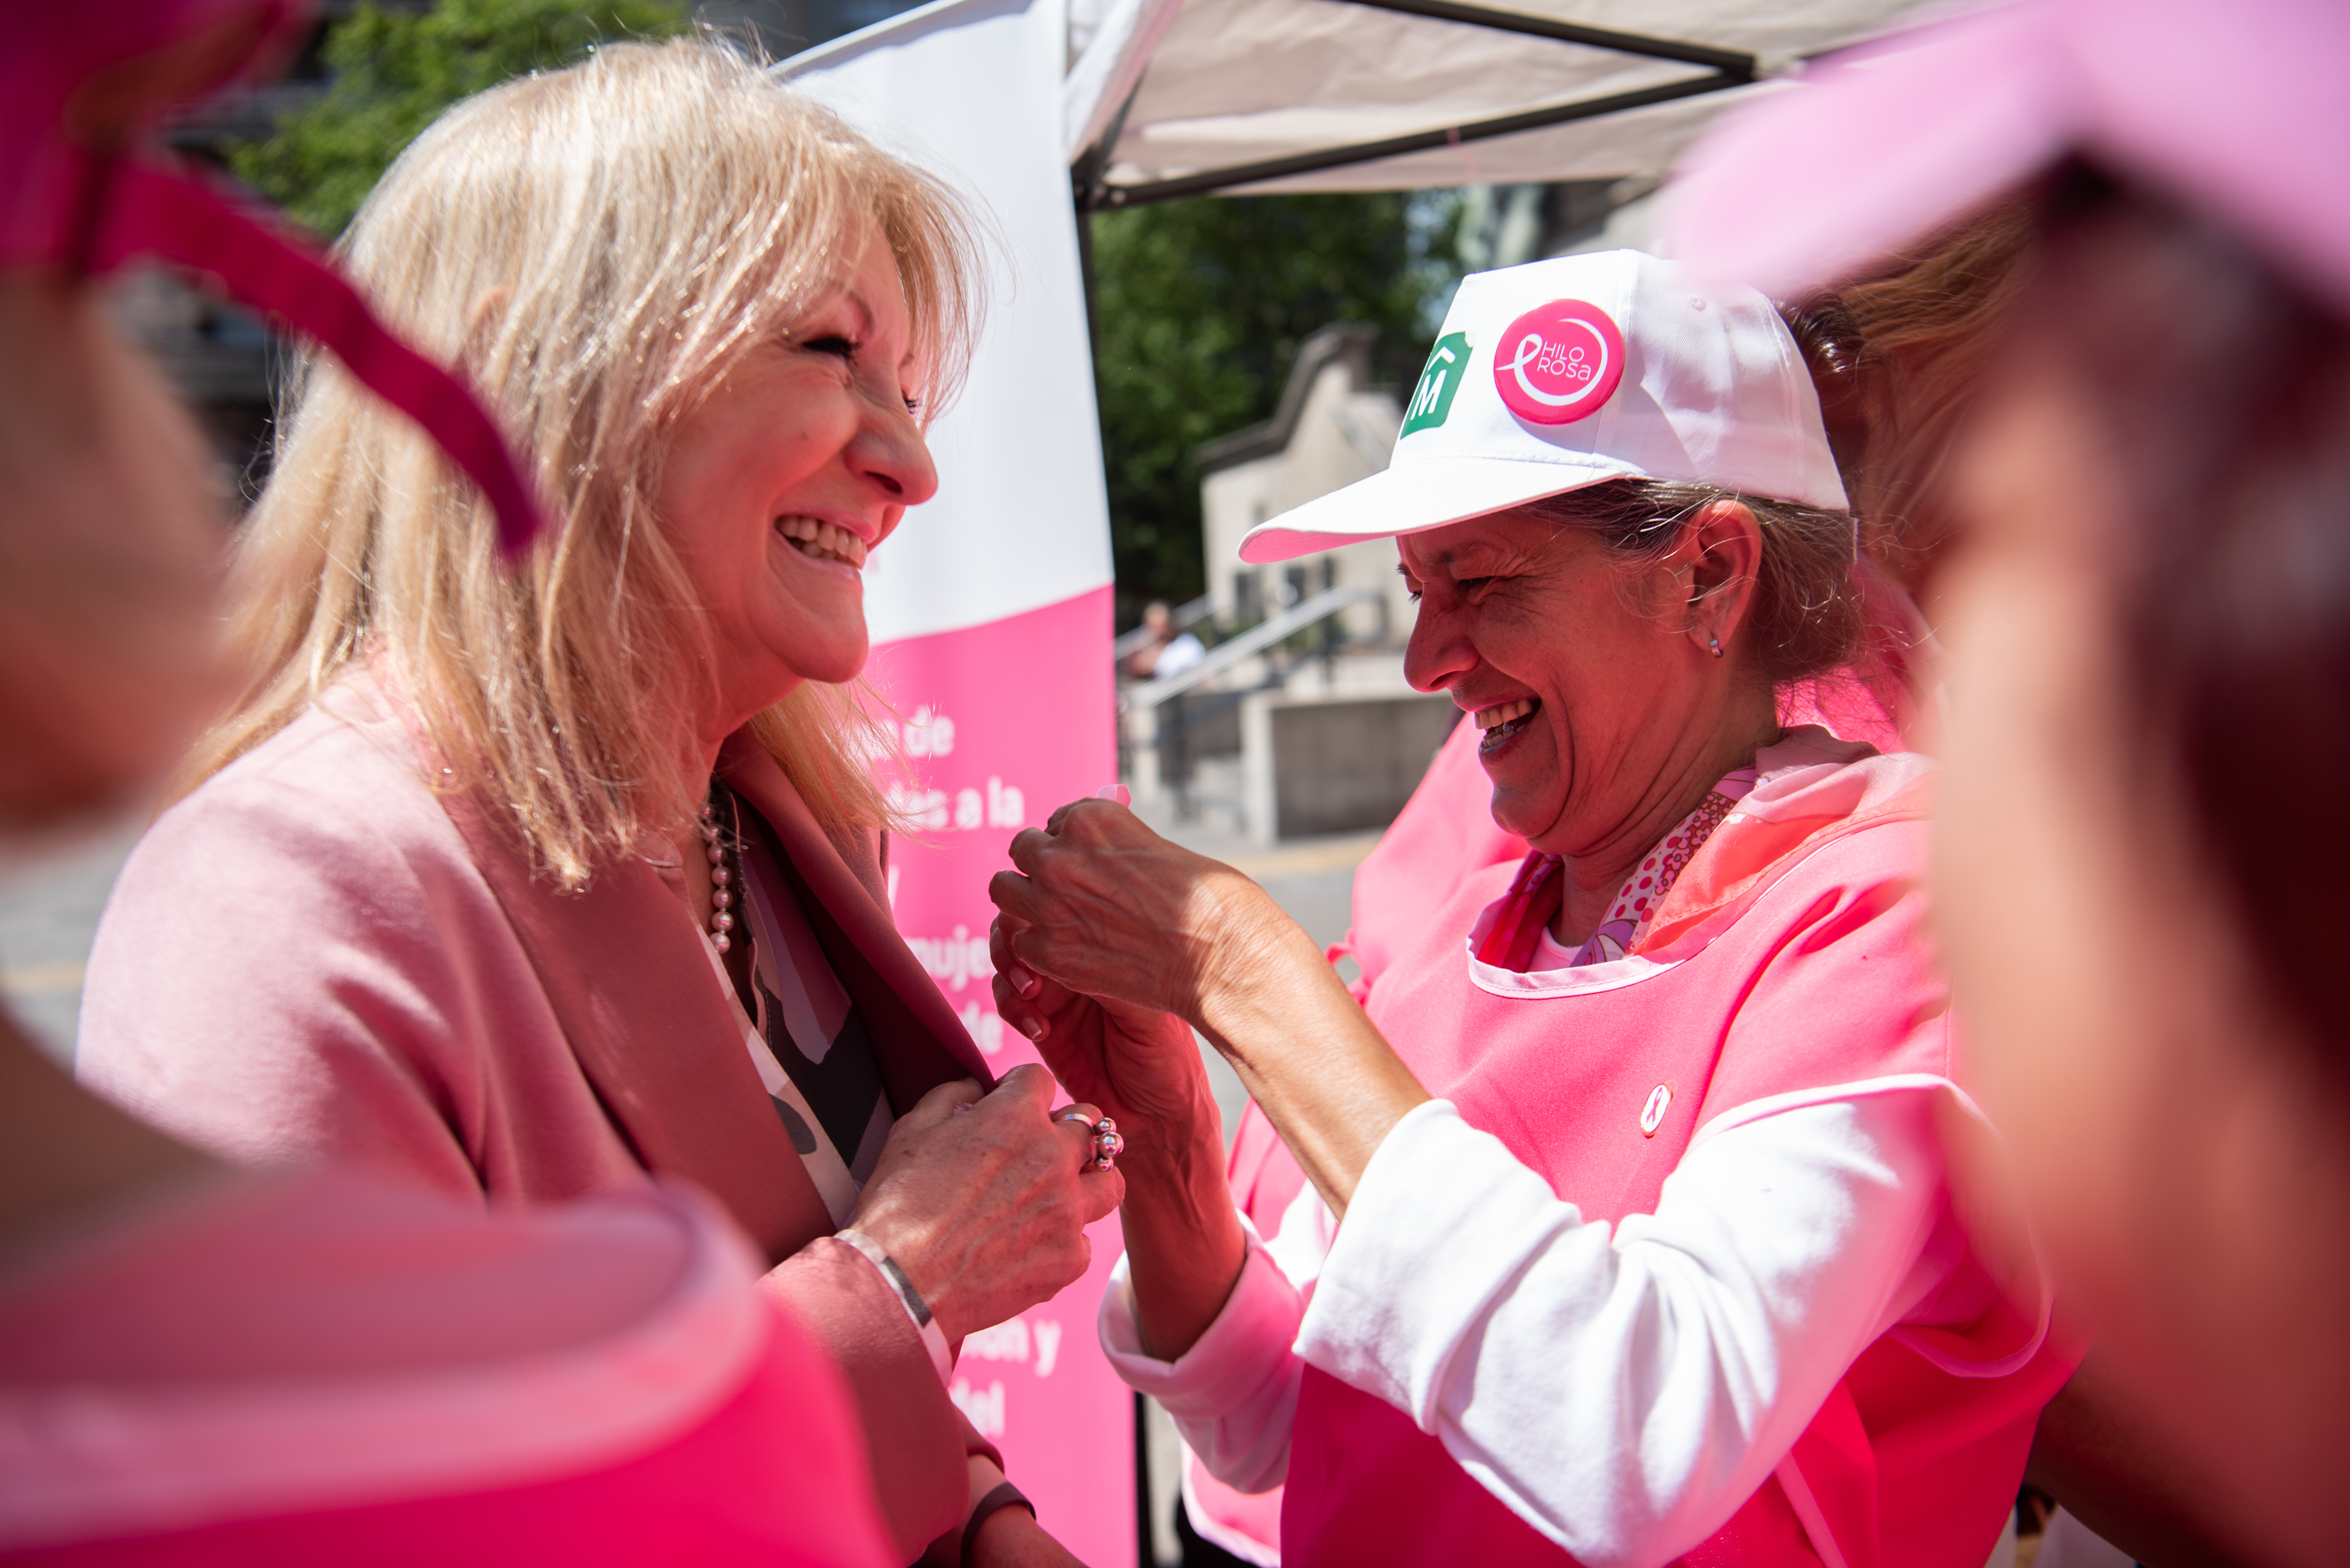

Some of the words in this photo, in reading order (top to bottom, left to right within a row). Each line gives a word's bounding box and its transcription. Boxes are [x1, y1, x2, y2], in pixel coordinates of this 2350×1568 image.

[1542, 341, 1585, 363] HILO
[1410, 369, 1448, 421] M
[903, 706, 956, 757] de
[954, 788, 984, 830] a
[987, 775, 1025, 829] la
[1033, 1318, 1062, 1378] y
